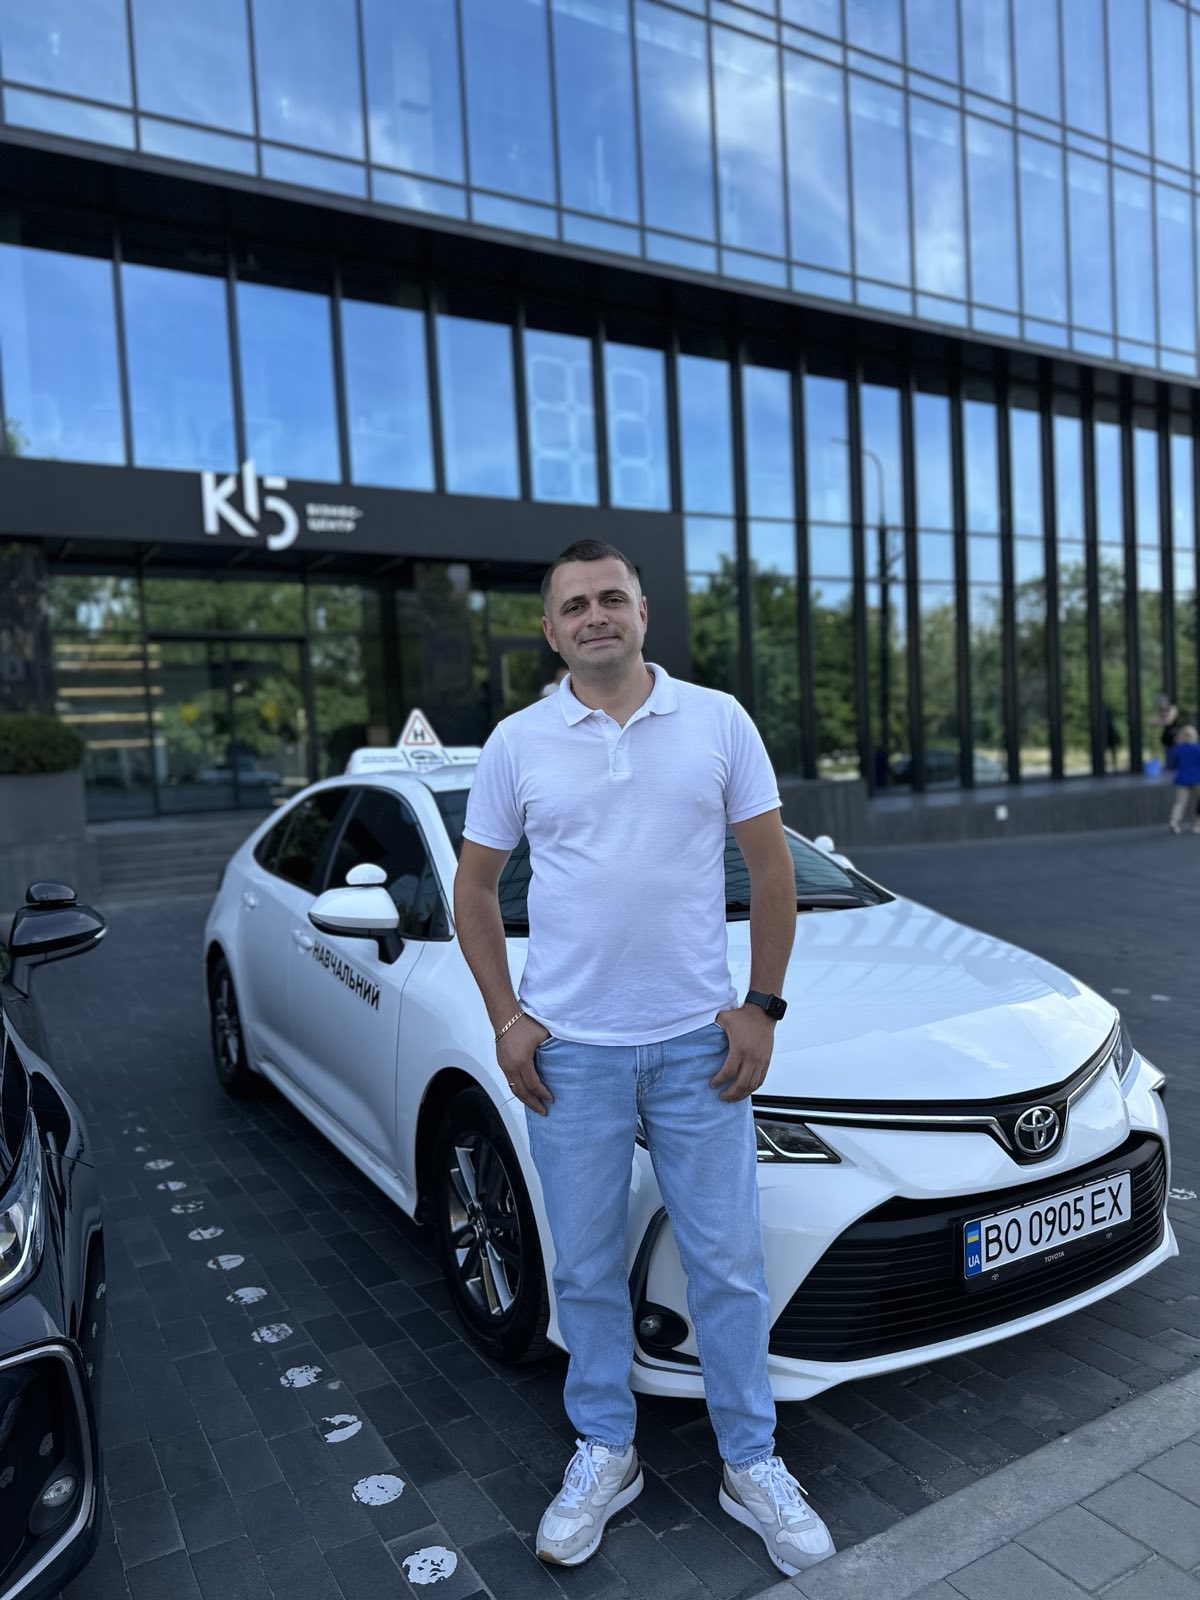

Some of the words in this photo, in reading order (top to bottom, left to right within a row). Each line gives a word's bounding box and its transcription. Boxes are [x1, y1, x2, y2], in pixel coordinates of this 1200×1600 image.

[312, 940, 381, 1011] НАВЧАЛЬНИЙ
[1029, 1196, 1085, 1246] 0905
[1091, 1182, 1123, 1226] EX
[968, 1254, 980, 1268] UA
[1044, 1251, 1065, 1263] TOYOTA
